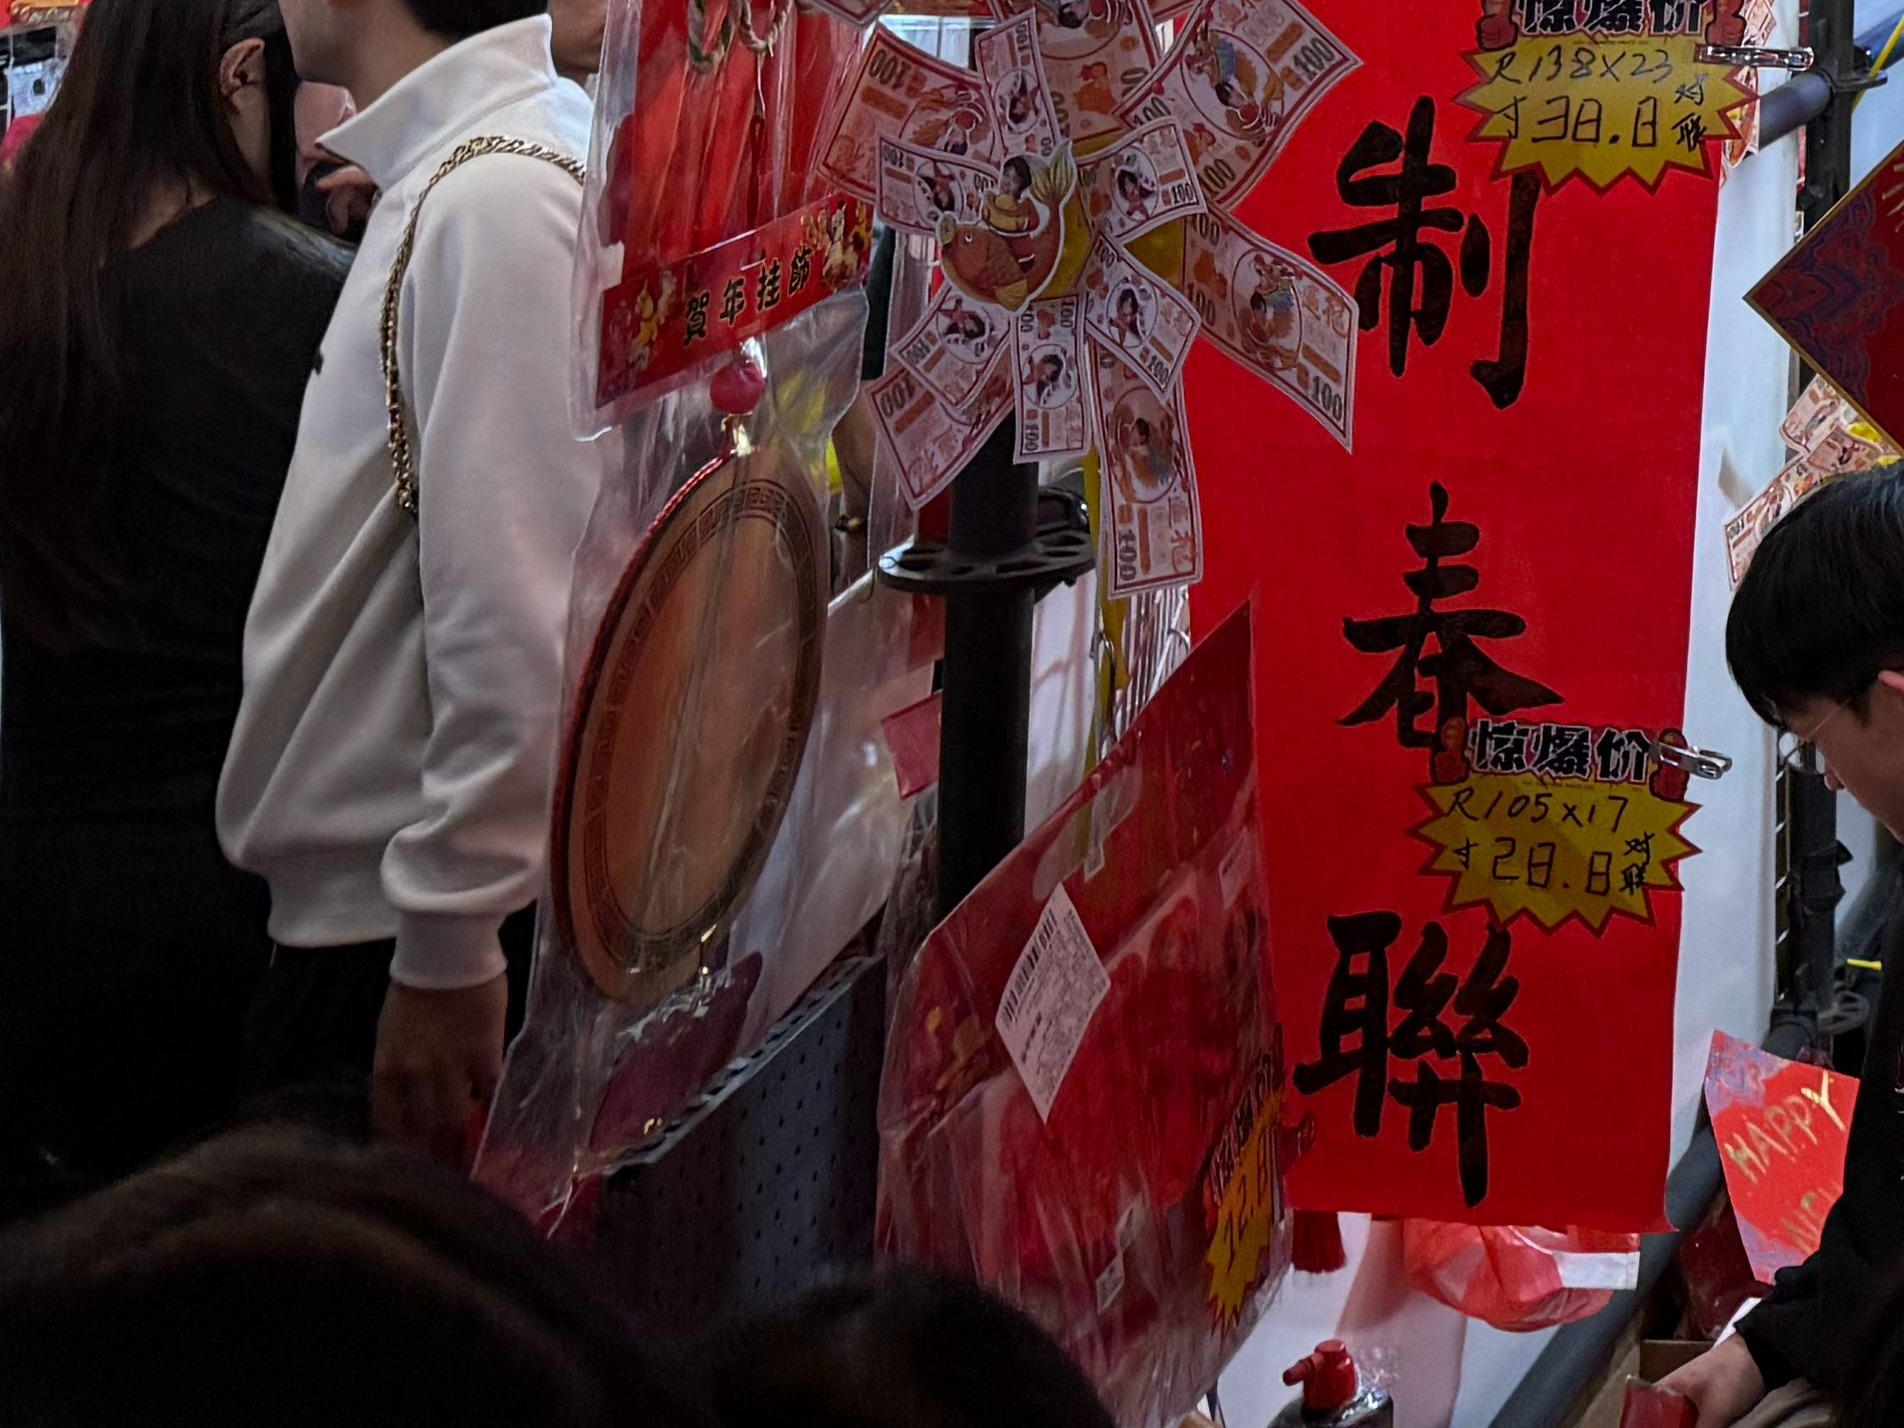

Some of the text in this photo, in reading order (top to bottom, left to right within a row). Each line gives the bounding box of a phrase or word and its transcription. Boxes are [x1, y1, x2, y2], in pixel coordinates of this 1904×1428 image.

[1467, 719, 1653, 784] 惊爆价
[1723, 1069, 1846, 1186] HAPPY
